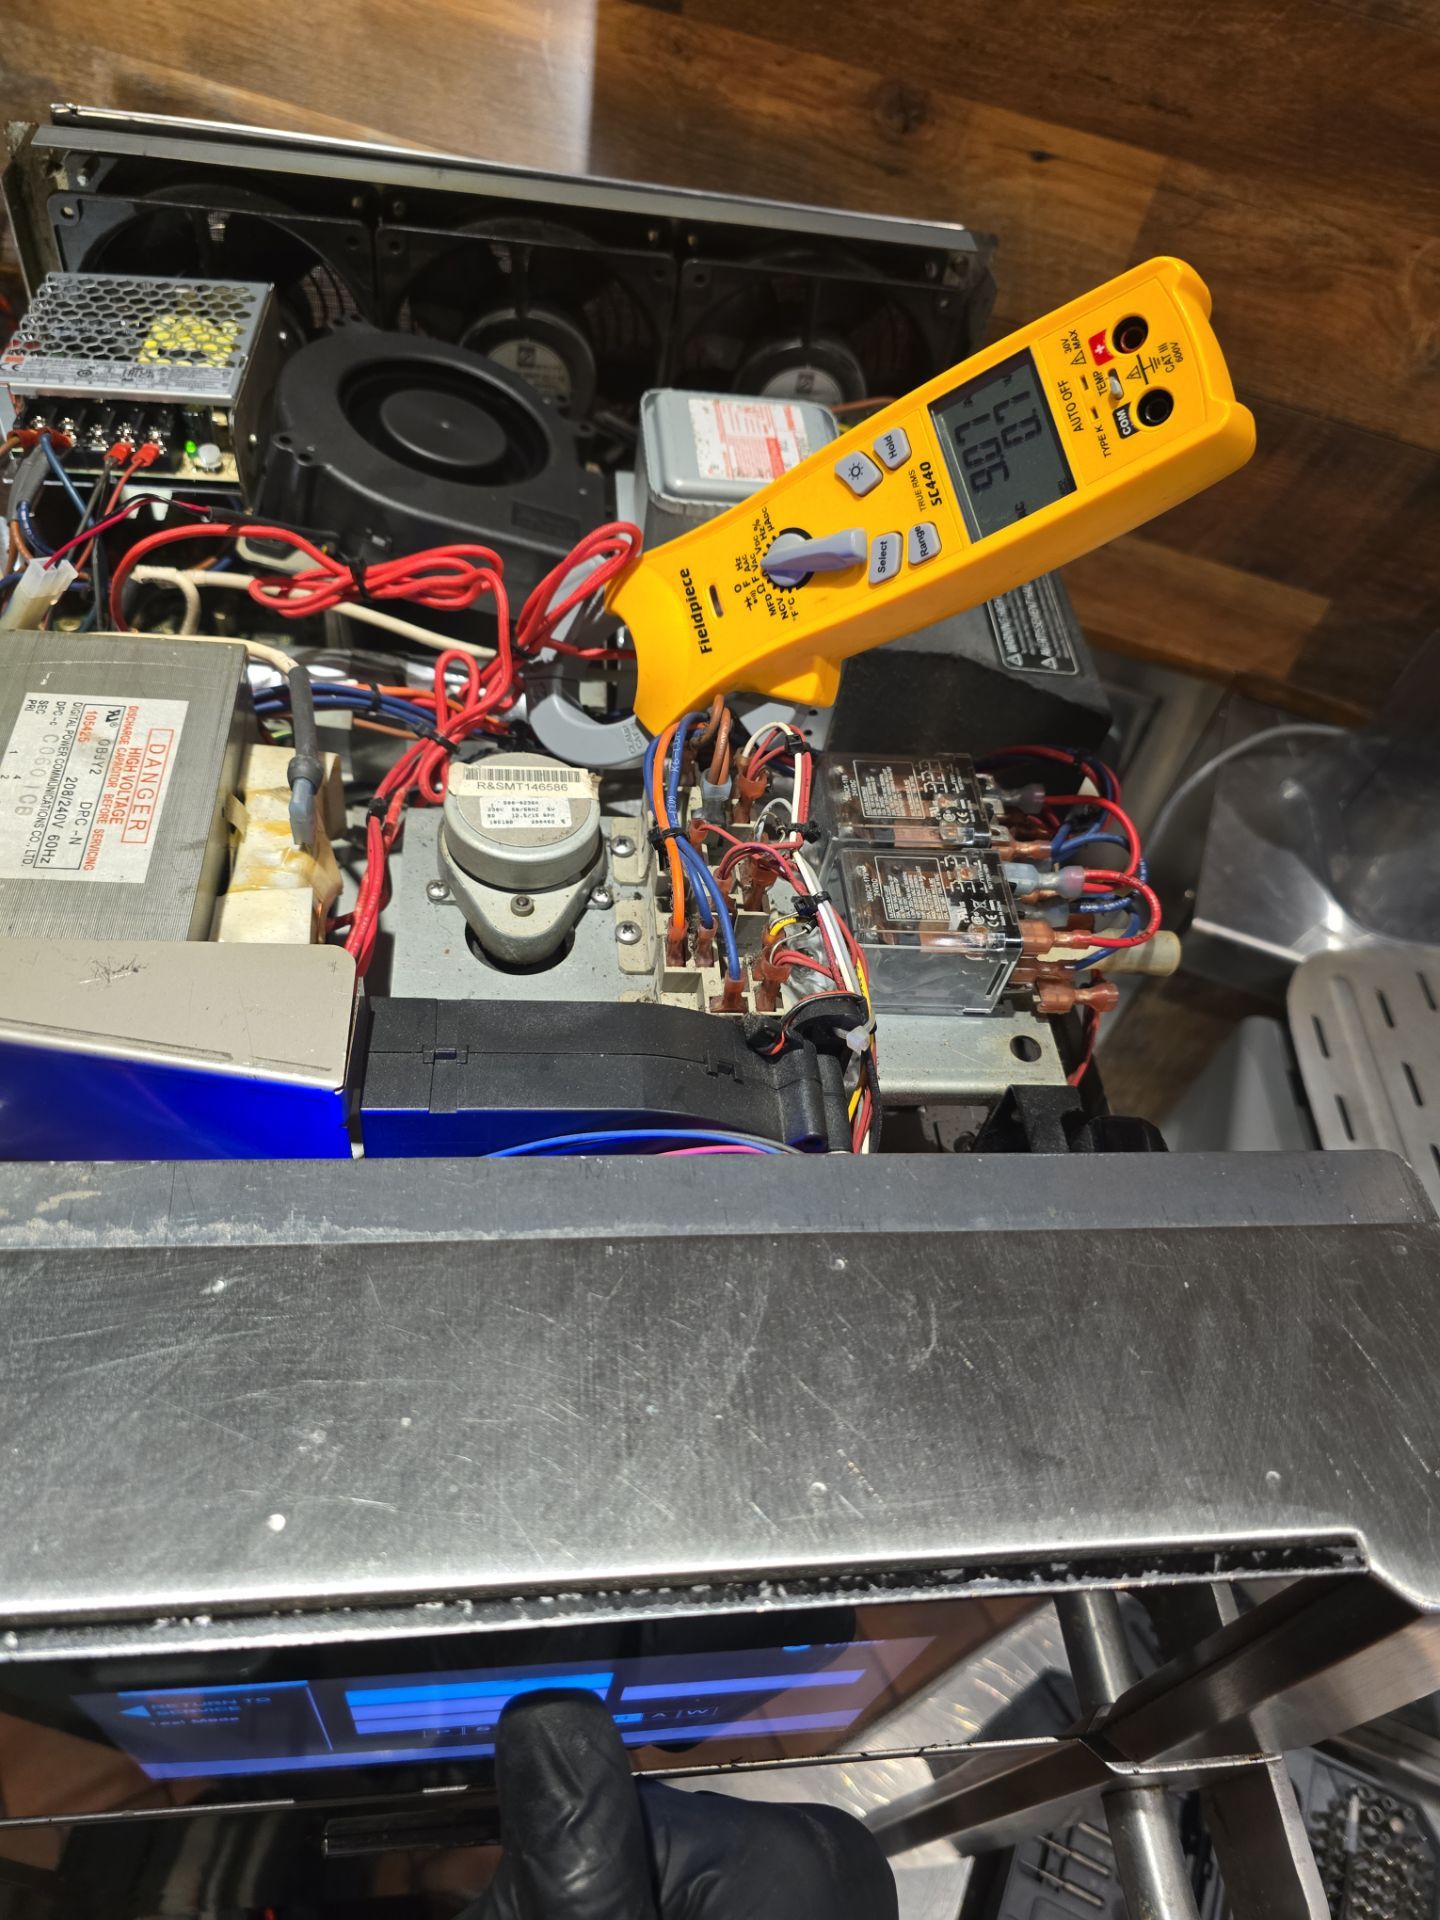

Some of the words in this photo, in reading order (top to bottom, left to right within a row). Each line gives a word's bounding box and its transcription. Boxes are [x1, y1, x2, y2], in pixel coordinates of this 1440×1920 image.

[1060, 338, 1072, 353] 30V
[1068, 329, 1081, 350] MAX
[1169, 341, 1184, 363] 600V
[1161, 354, 1175, 373] CAT
[1057, 380, 1073, 401] OFF
[1092, 370, 1107, 396] TEMP
[1065, 401, 1084, 432] AUTO
[1095, 424, 1104, 433] K
[1116, 409, 1131, 436] COM
[884, 434, 897, 459] Hold
[1097, 434, 1111, 458] TYPE
[908, 469, 920, 488] RMS
[919, 461, 942, 507] SC440
[914, 489, 926, 512] TRUE
[914, 525, 929, 558] Range
[877, 540, 888, 574] Select
[680, 568, 713, 654] Fieldpiece
[764, 593, 777, 617] MFD
[776, 597, 789, 620] NCV
[25, 699, 38, 712] PRI
[35, 700, 49, 715] SEC
[66, 702, 83, 728] DIGITAL
[119, 705, 139, 745] DISCHARGE
[56, 729, 74, 757] POWER
[106, 747, 127, 788] CAPACITOR
[123, 747, 143, 772] HIGH
[33, 758, 65, 829] COMMUNICATIONS
[128, 744, 166, 831] DANGER
[476, 781, 569, 792] R&SMT146586
[52, 777, 79, 829] 208/240V
[96, 794, 114, 824] BEFORE
[109, 775, 136, 825] VOLTAGE
[21, 849, 36, 867] LTD.
[40, 834, 60, 864] 60Hz
[83, 828, 105, 871] SERVICING
